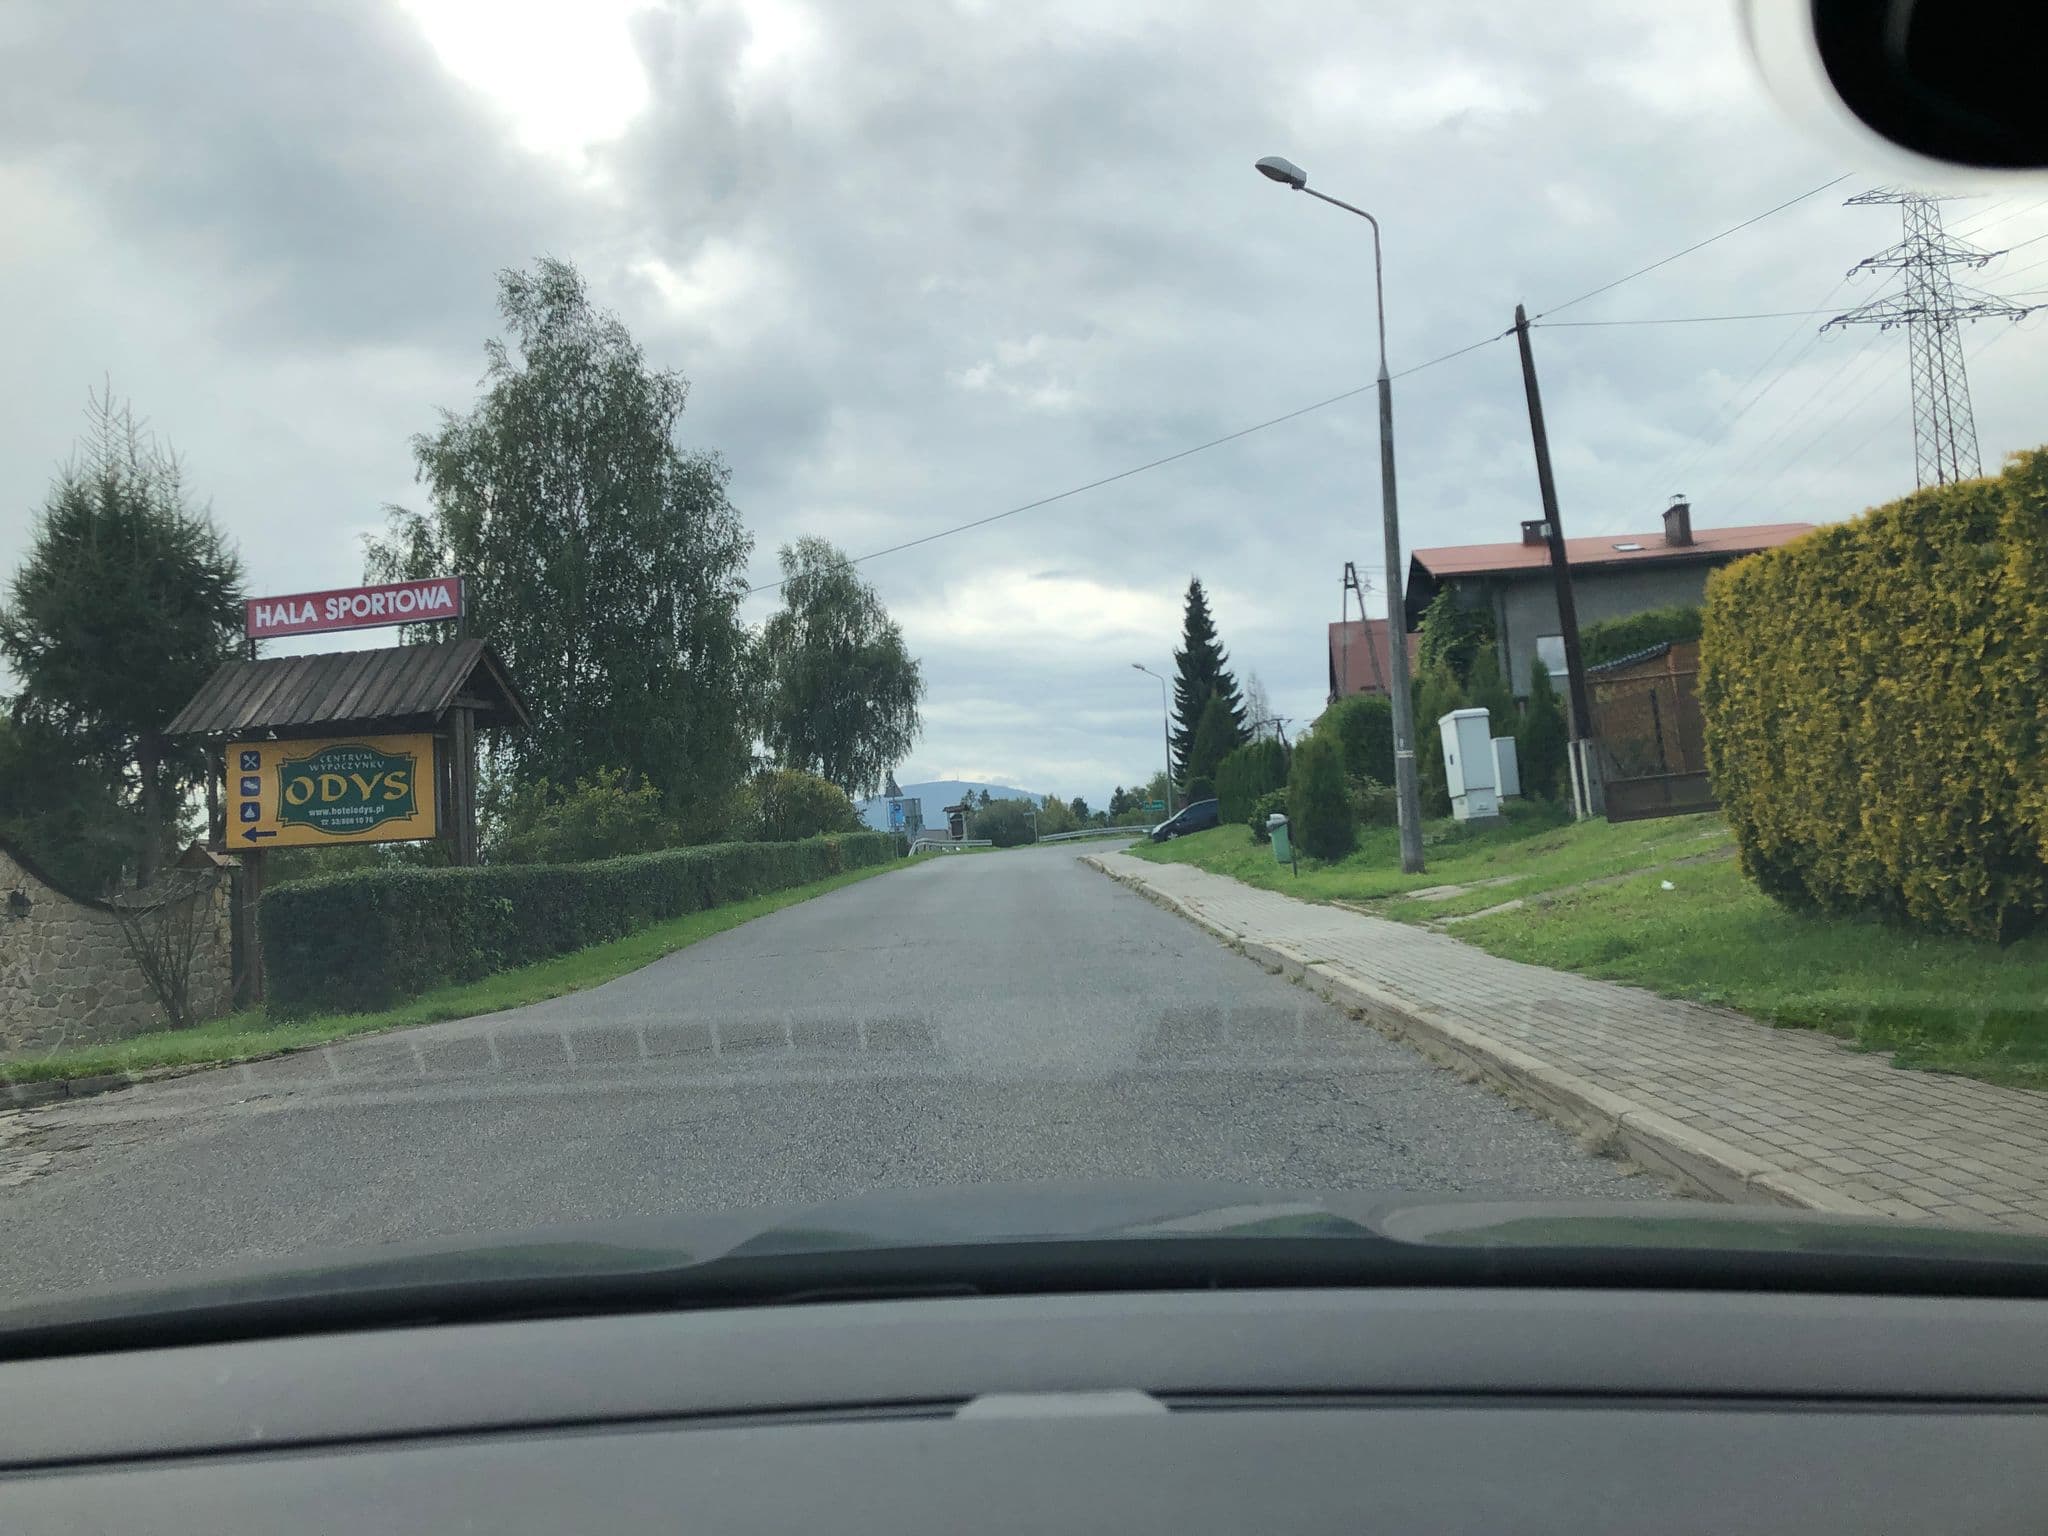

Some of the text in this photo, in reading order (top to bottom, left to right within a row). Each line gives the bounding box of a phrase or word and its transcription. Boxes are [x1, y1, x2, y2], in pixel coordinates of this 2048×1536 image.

[256, 586, 452, 627] HALA SPORTOWA
[320, 754, 372, 763] CENTRUM
[309, 762, 384, 771] WYPOCZYNKU
[286, 772, 409, 805] ODYS
[309, 805, 384, 817] www.hotelodys.pl
